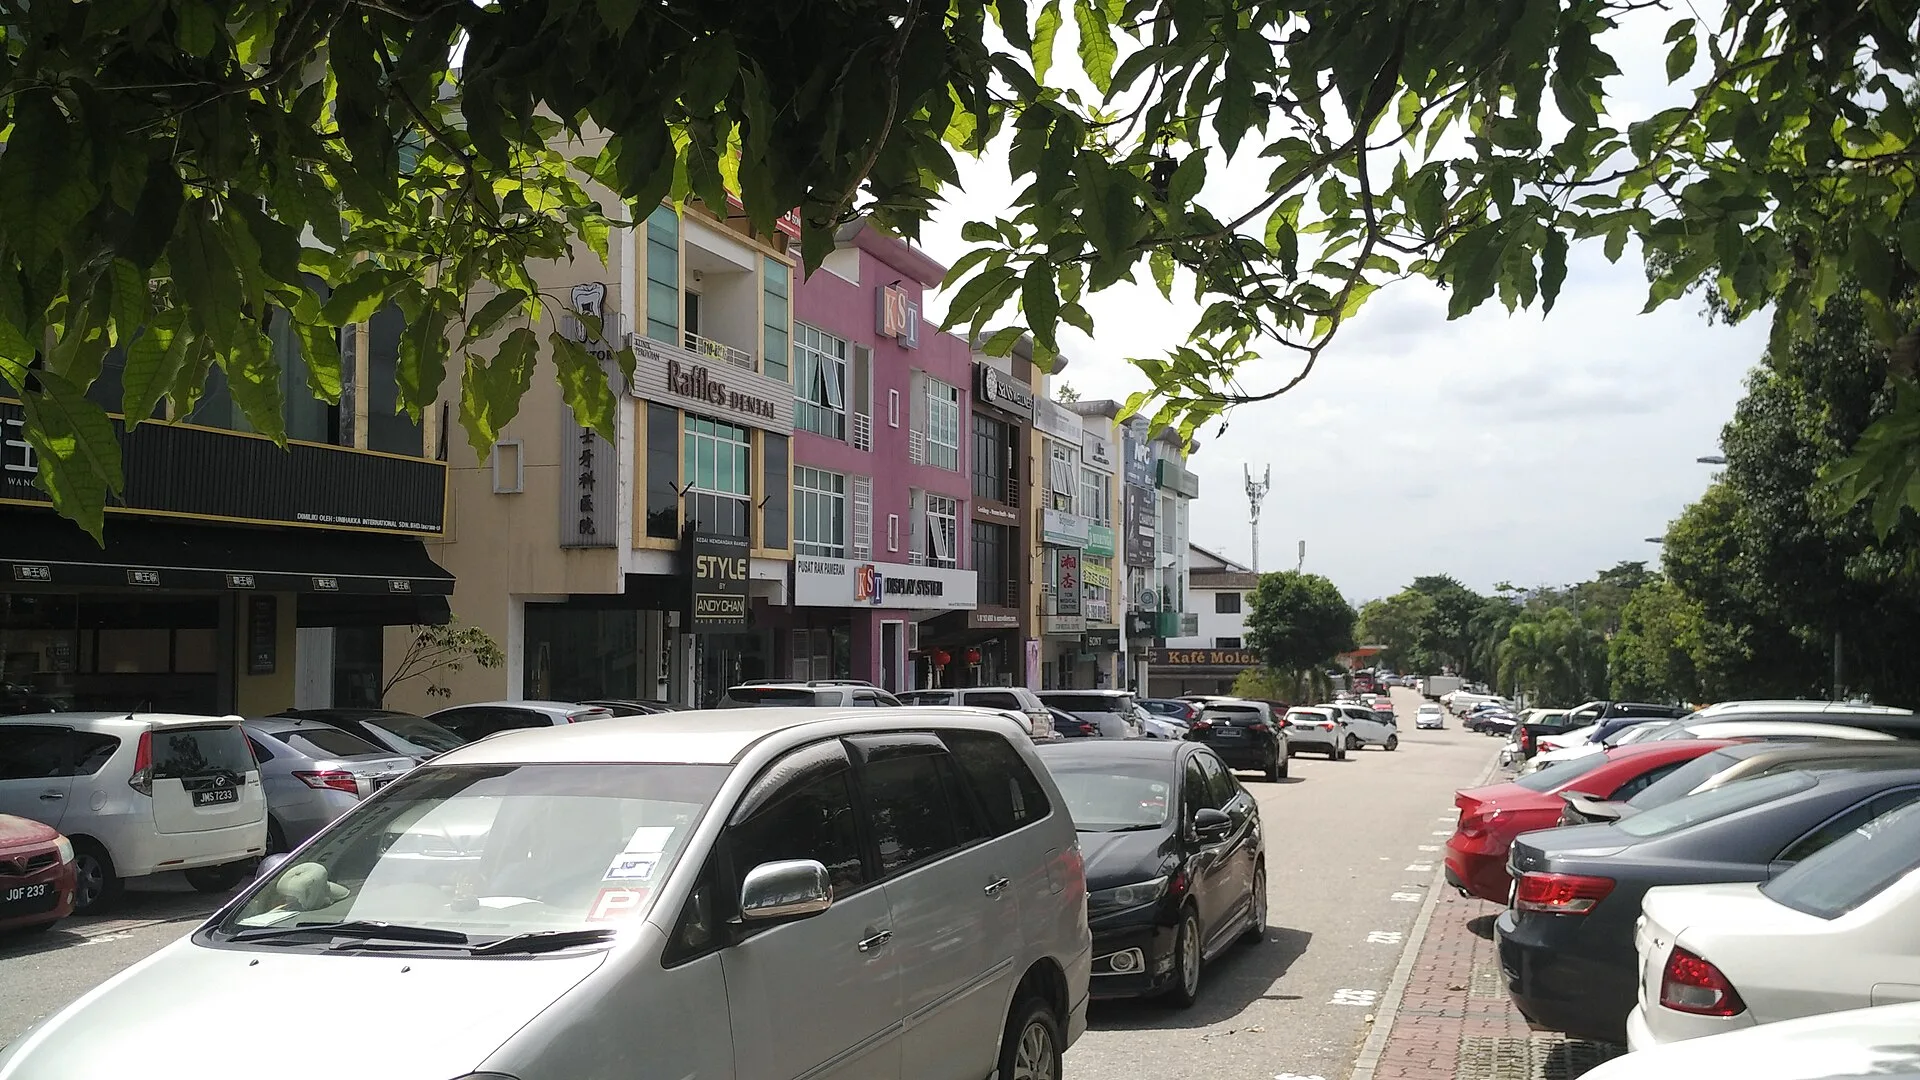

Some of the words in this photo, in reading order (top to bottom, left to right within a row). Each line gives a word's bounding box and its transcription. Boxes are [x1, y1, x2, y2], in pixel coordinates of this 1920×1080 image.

[885, 292, 918, 342] KST
[669, 359, 726, 405] Raffles
[730, 392, 775, 418] DENTAL
[696, 555, 746, 580] STYLE
[798, 560, 814, 574] PUSAT
[813, 562, 824, 575] RAK
[824, 562, 845, 576] PAMERAN
[858, 567, 882, 601] KST
[886, 577, 917, 596] DISPLAY
[917, 579, 944, 597] SYSTEM
[698, 600, 721, 612] ANDY
[721, 600, 743, 613] CHAN
[1168, 651, 1206, 664] Kafé
[214, 790, 232, 800] 7233
[6, 887, 25, 901] JQF
[27, 884, 45, 898] 233
